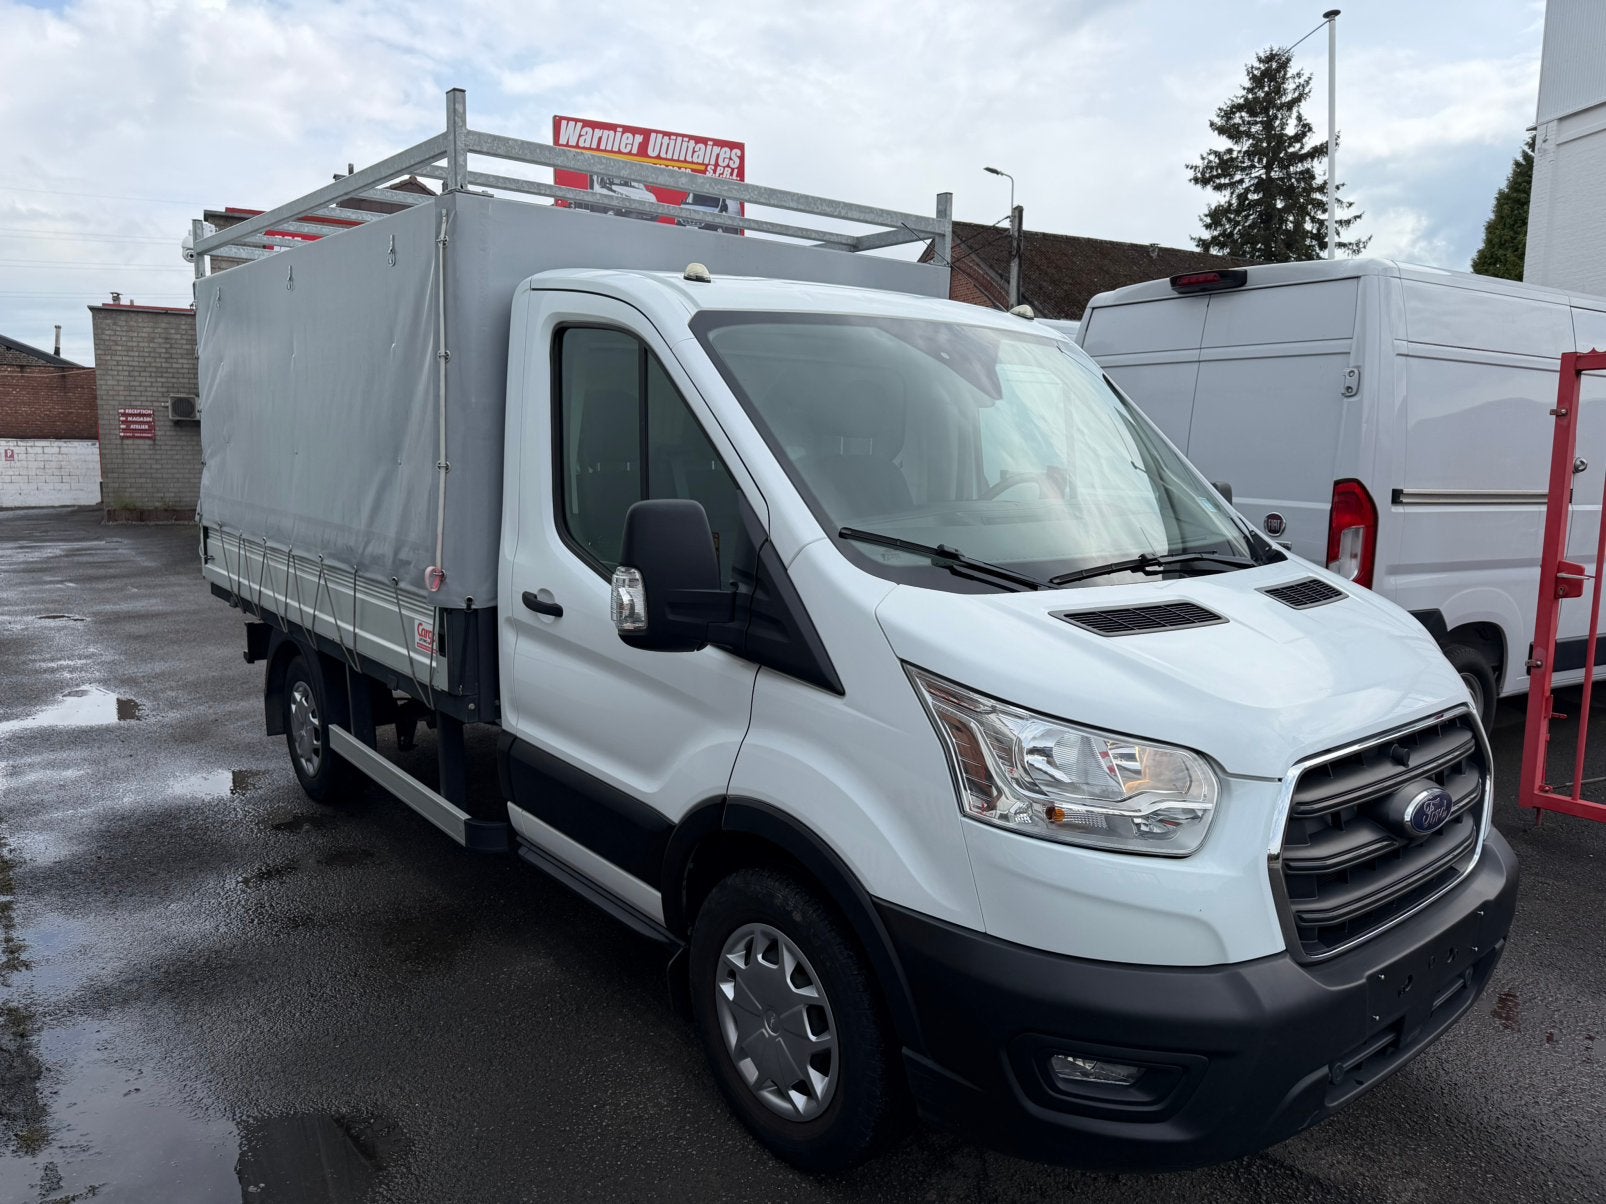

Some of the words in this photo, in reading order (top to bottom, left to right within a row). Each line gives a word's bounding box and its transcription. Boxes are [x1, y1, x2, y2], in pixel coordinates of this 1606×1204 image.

[559, 119, 643, 154] Warnier
[647, 132, 742, 169] Utilitaires
[1422, 797, 1448, 828] Ford
